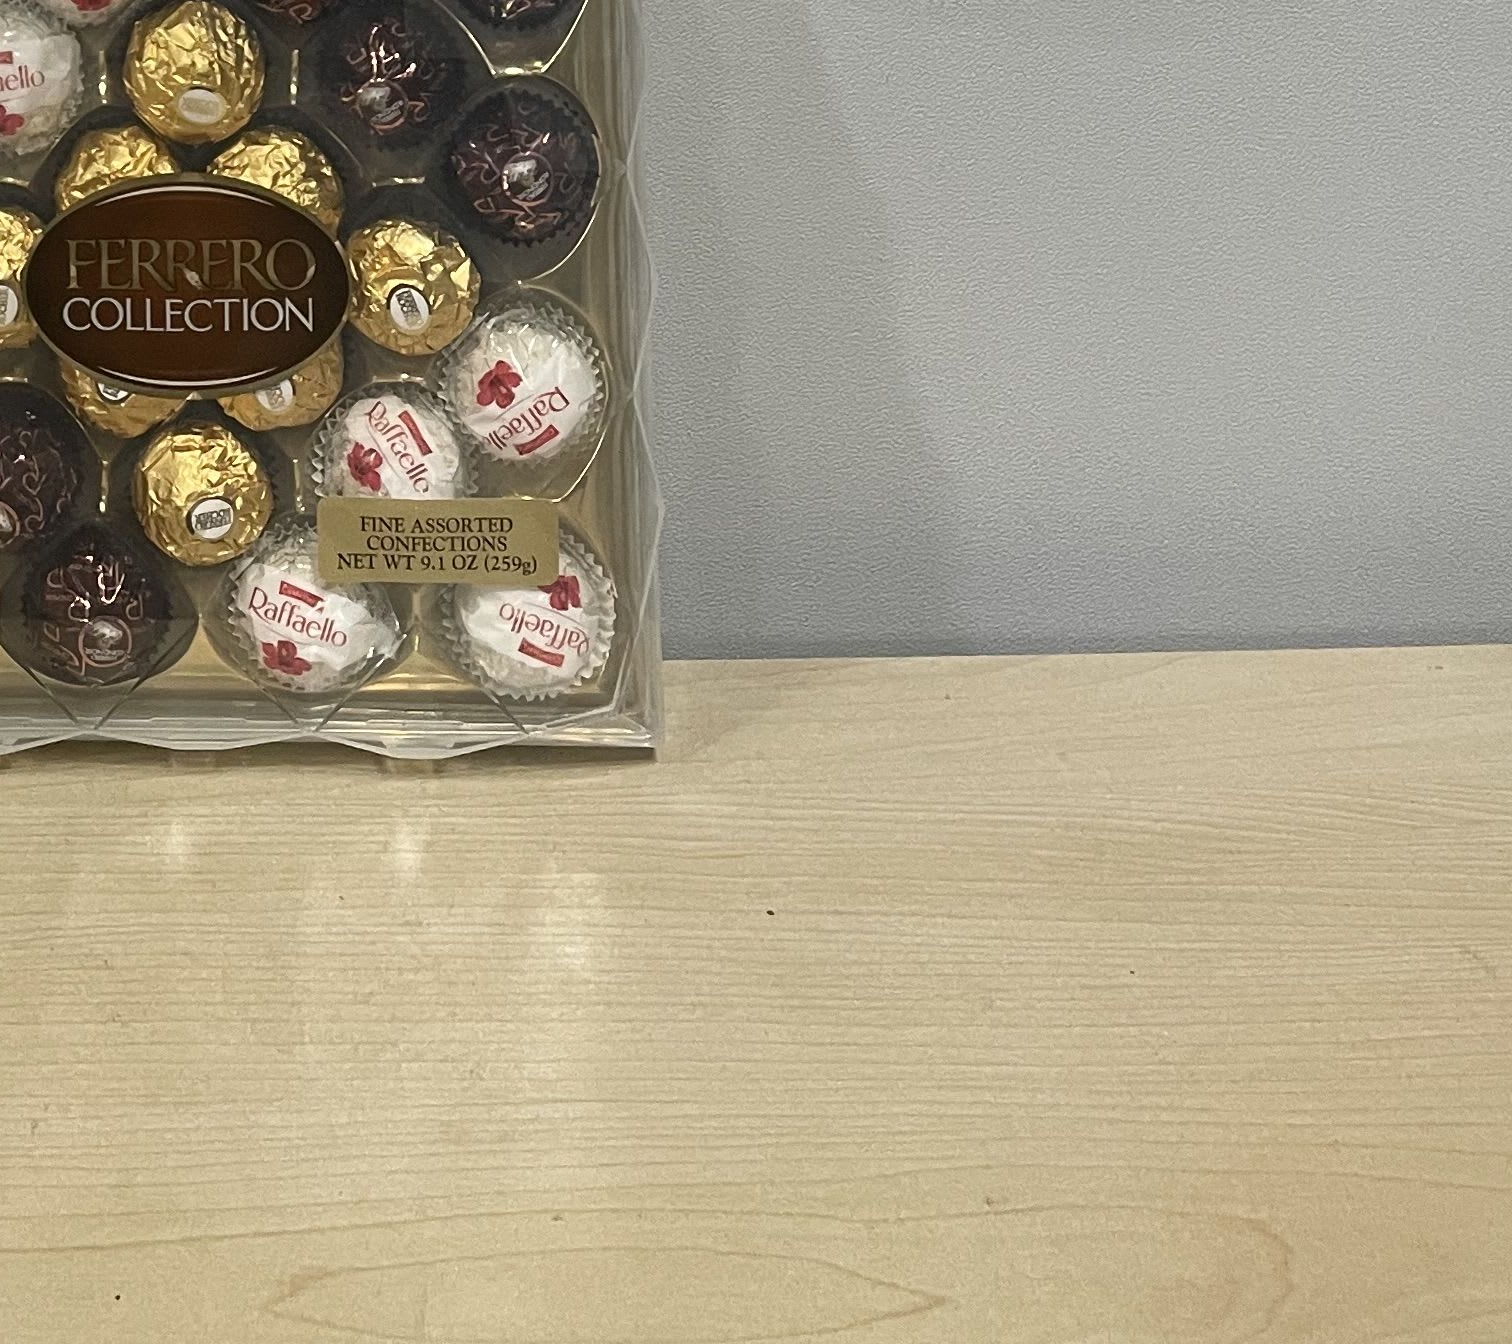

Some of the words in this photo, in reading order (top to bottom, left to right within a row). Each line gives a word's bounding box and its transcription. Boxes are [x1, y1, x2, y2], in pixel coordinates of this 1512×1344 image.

[65, 237, 317, 293] FERRERO
[61, 296, 314, 333] COLLECTION
[483, 386, 570, 451] Raffaell
[364, 400, 430, 494] Raffaello
[359, 515, 406, 533] FINE
[410, 515, 514, 534] ASSORTED
[366, 535, 508, 552] CONFECTIONS
[336, 553, 378, 570] NET
[382, 553, 416, 571] WT
[420, 555, 444, 571] 9.1
[452, 554, 479, 571] OZ
[483, 555, 538, 576] (259g)
[248, 586, 348, 647] Raffaello
